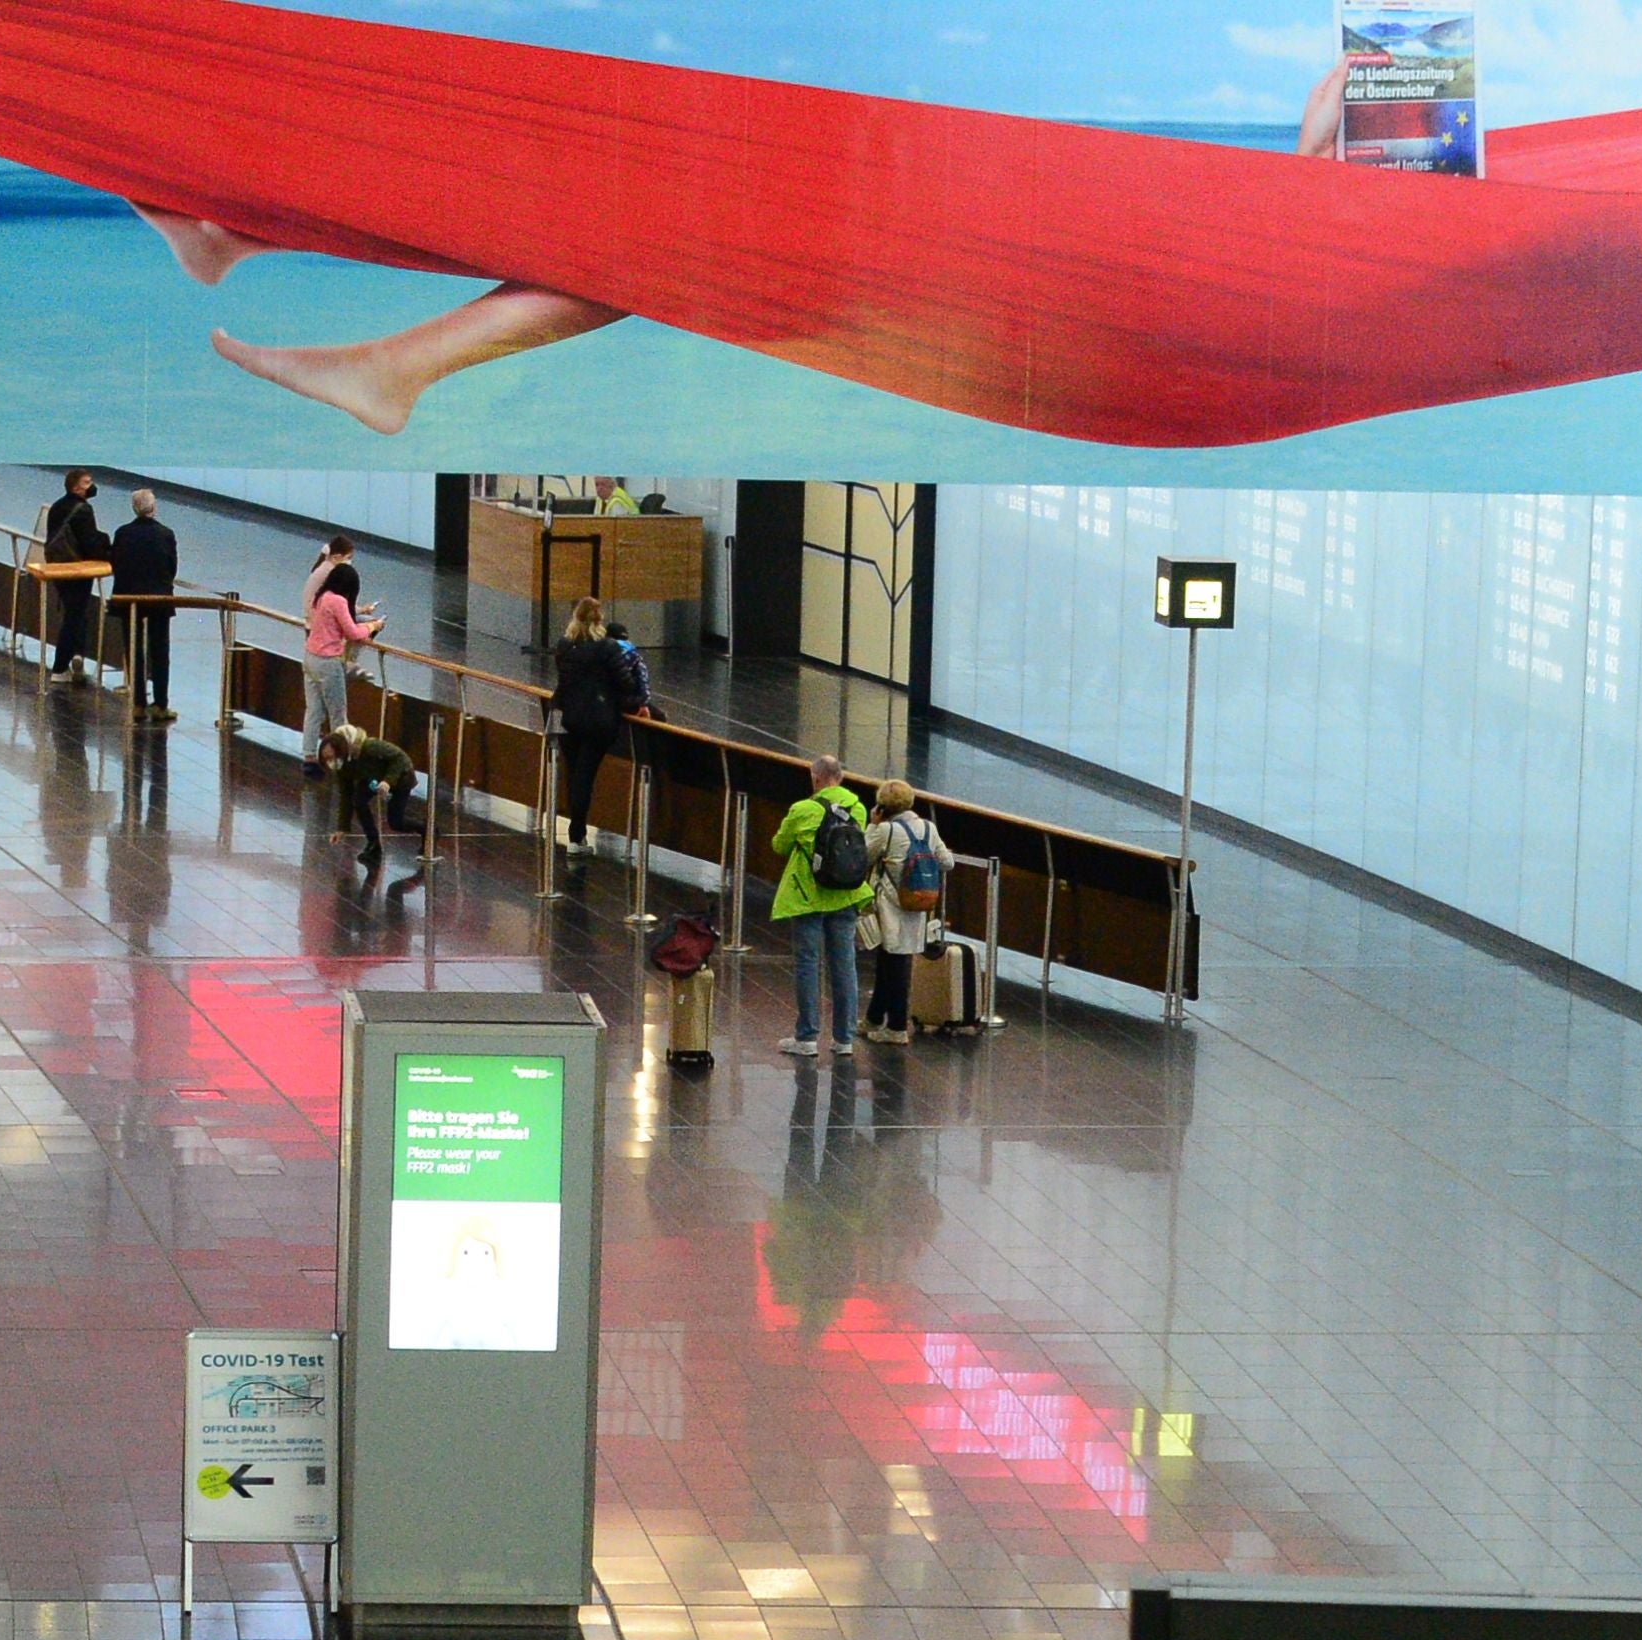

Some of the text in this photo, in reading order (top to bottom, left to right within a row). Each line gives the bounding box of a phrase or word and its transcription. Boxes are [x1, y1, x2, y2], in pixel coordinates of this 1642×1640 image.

[1366, 66, 1455, 83] Lieblingszeitung
[1345, 83, 1436, 99] der Österreicher
[408, 1109, 519, 1126] Bitte tragen Sie
[407, 1147, 502, 1163] Please wear your
[406, 1161, 472, 1174] FFP2 mask!
[201, 1354, 324, 1367] COVID-19 Test
[202, 1425, 237, 1434] OFFICE
[241, 1425, 268, 1434] PARK
